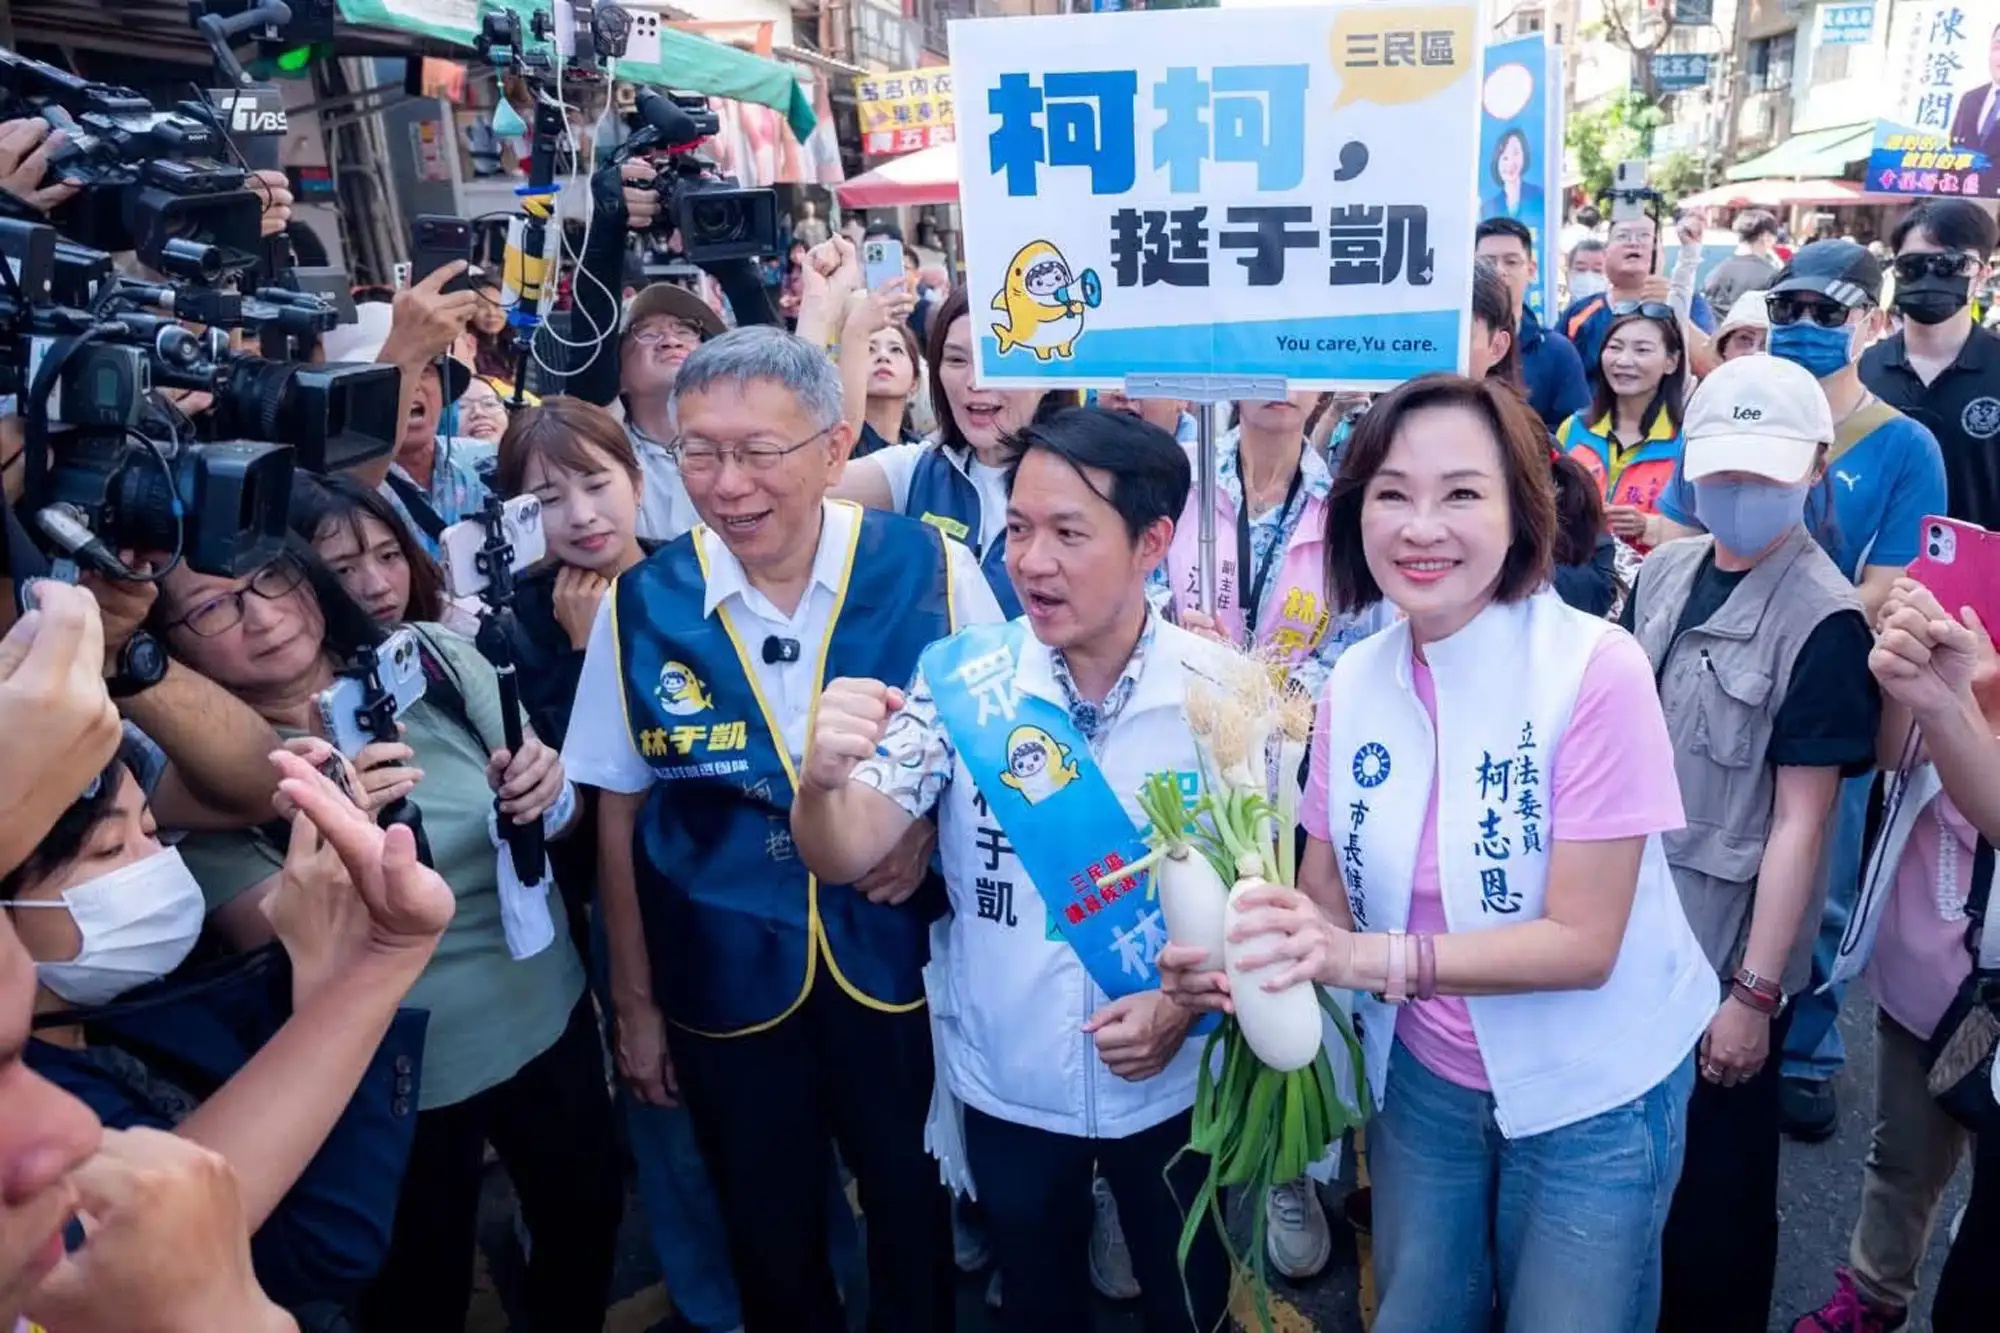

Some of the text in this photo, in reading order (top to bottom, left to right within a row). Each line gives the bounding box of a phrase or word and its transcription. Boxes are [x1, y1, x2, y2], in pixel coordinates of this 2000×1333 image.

[1345, 31, 1454, 67] 三民區
[221, 97, 288, 131] TVBS
[988, 63, 1370, 197] 柯柯，
[1110, 203, 1435, 288] 挺于凱
[1276, 335, 1311, 352] You
[1733, 406, 1761, 420] Lee
[639, 720, 748, 757] 林于凱
[1513, 720, 1543, 856] 立法委員
[972, 778, 1018, 928] 于凱
[1343, 798, 1369, 933] 市長候選
[1474, 750, 1524, 915] 柯志恩
